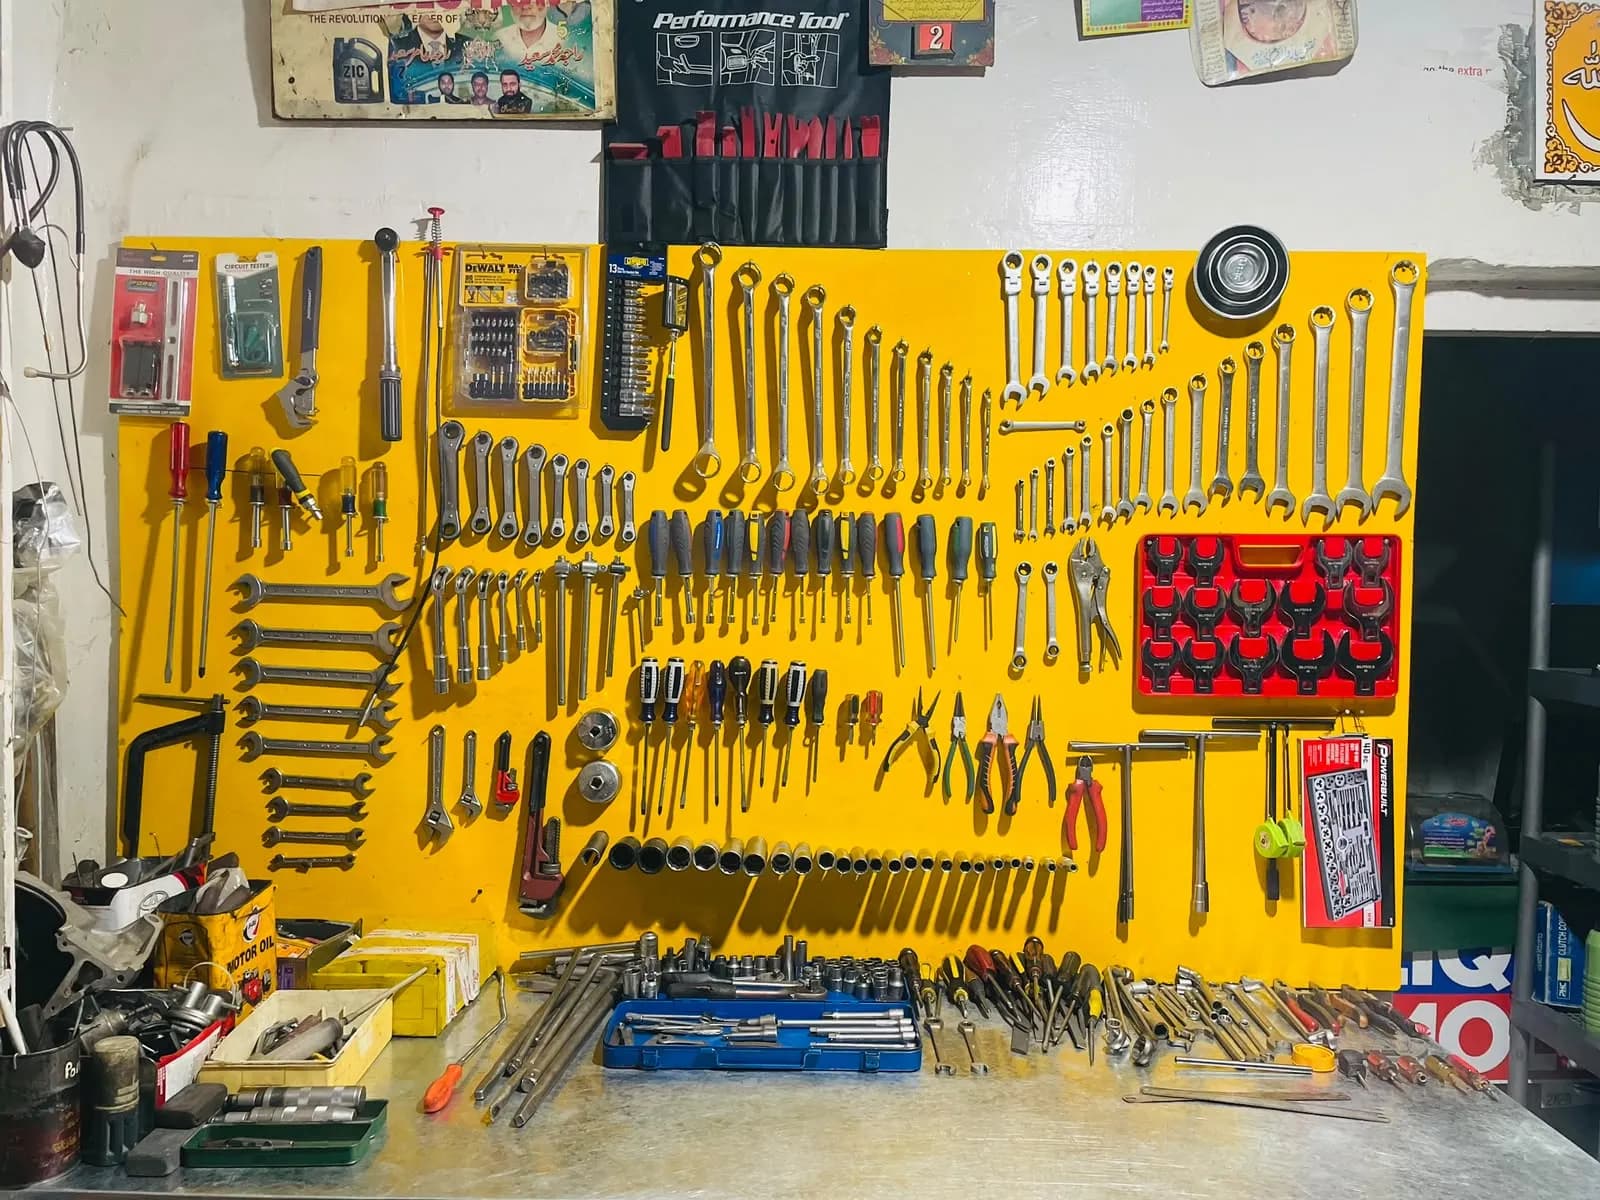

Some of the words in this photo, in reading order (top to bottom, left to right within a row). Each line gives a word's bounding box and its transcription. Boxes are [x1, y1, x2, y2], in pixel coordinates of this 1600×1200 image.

[309, 14, 327, 24] THE
[445, 14, 459, 24] OF
[653, 10, 796, 30] Performance
[798, 12, 846, 30] Tool
[929, 25, 945, 49] 2
[343, 65, 365, 78] ZIC
[1457, 66, 1482, 77] extra
[609, 264, 618, 273] 13
[1363, 742, 1371, 754] 40
[1377, 743, 1390, 817] POWERBUILT
[1558, 931, 1568, 956] CLUTCH
[227, 945, 257, 974] MOTOR
[259, 936, 274, 953] OIL
